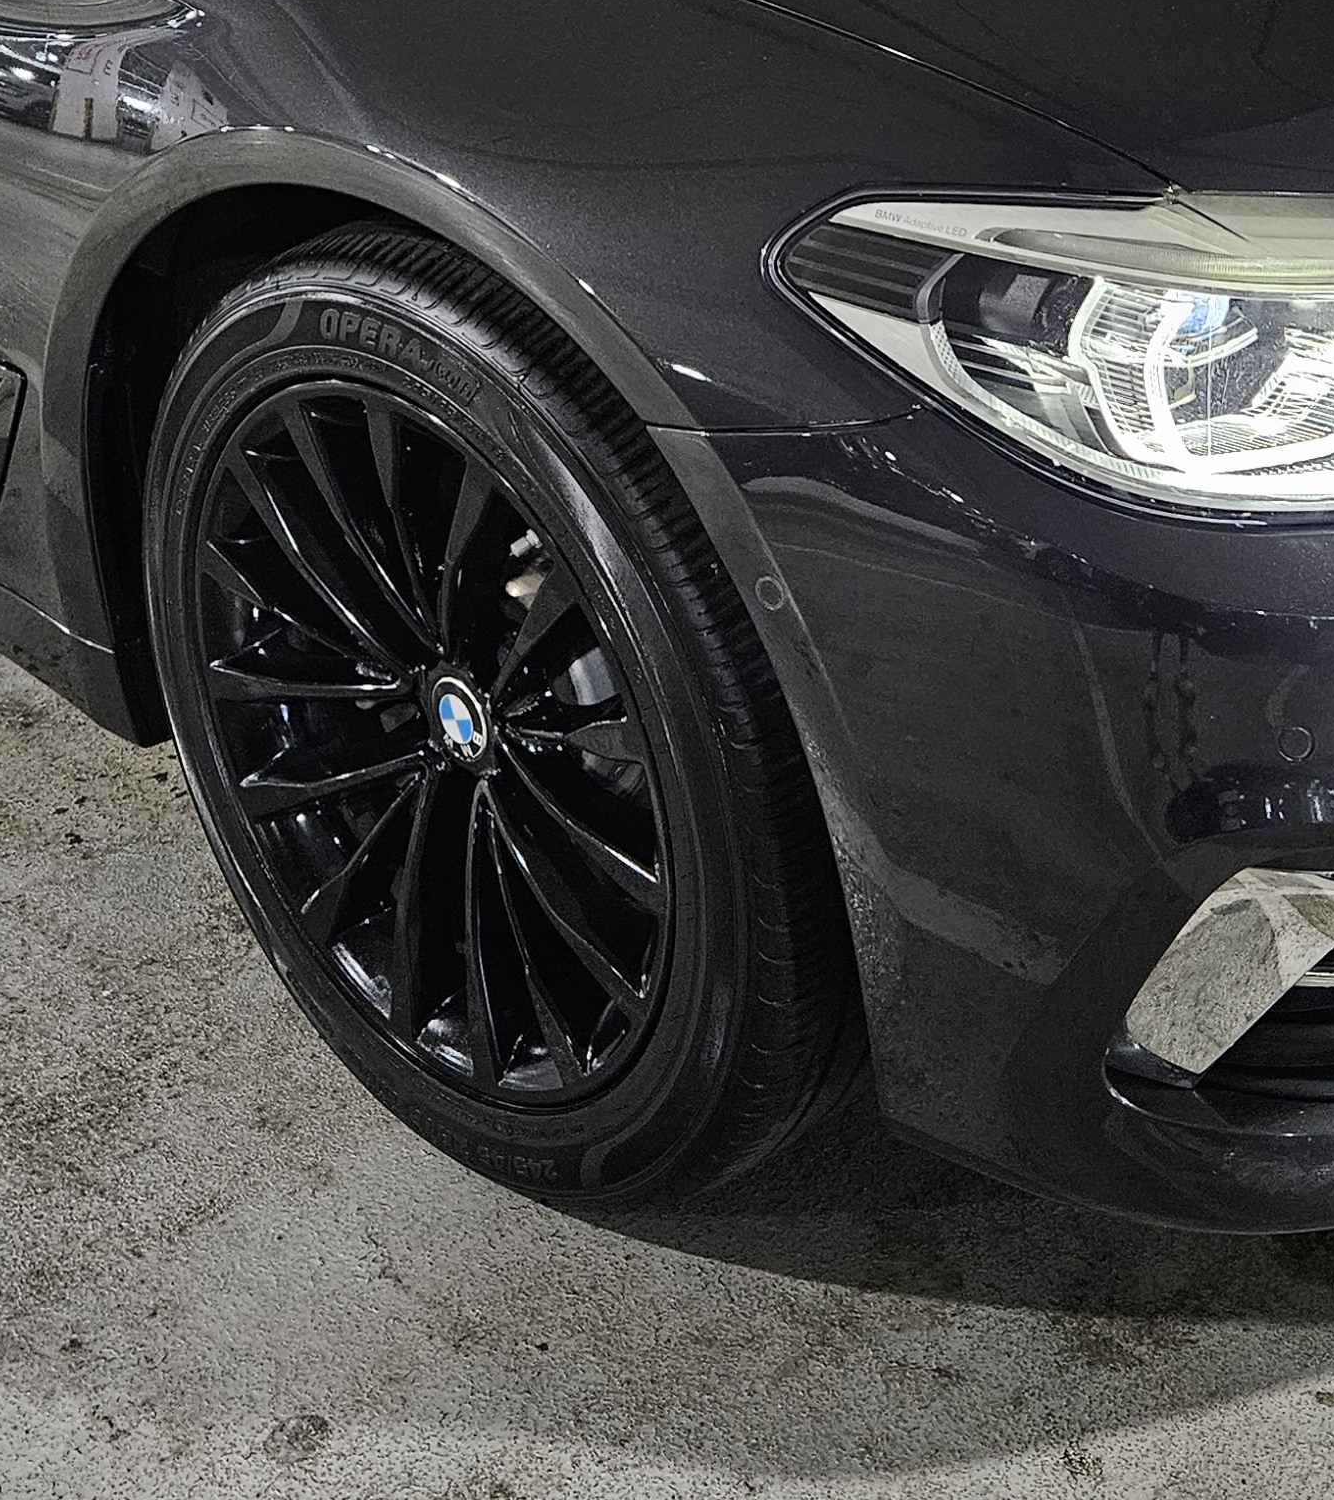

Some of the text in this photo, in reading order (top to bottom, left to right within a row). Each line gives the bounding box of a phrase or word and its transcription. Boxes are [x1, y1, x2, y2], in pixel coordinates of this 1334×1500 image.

[875, 208, 968, 238] BMW Adaptive LED
